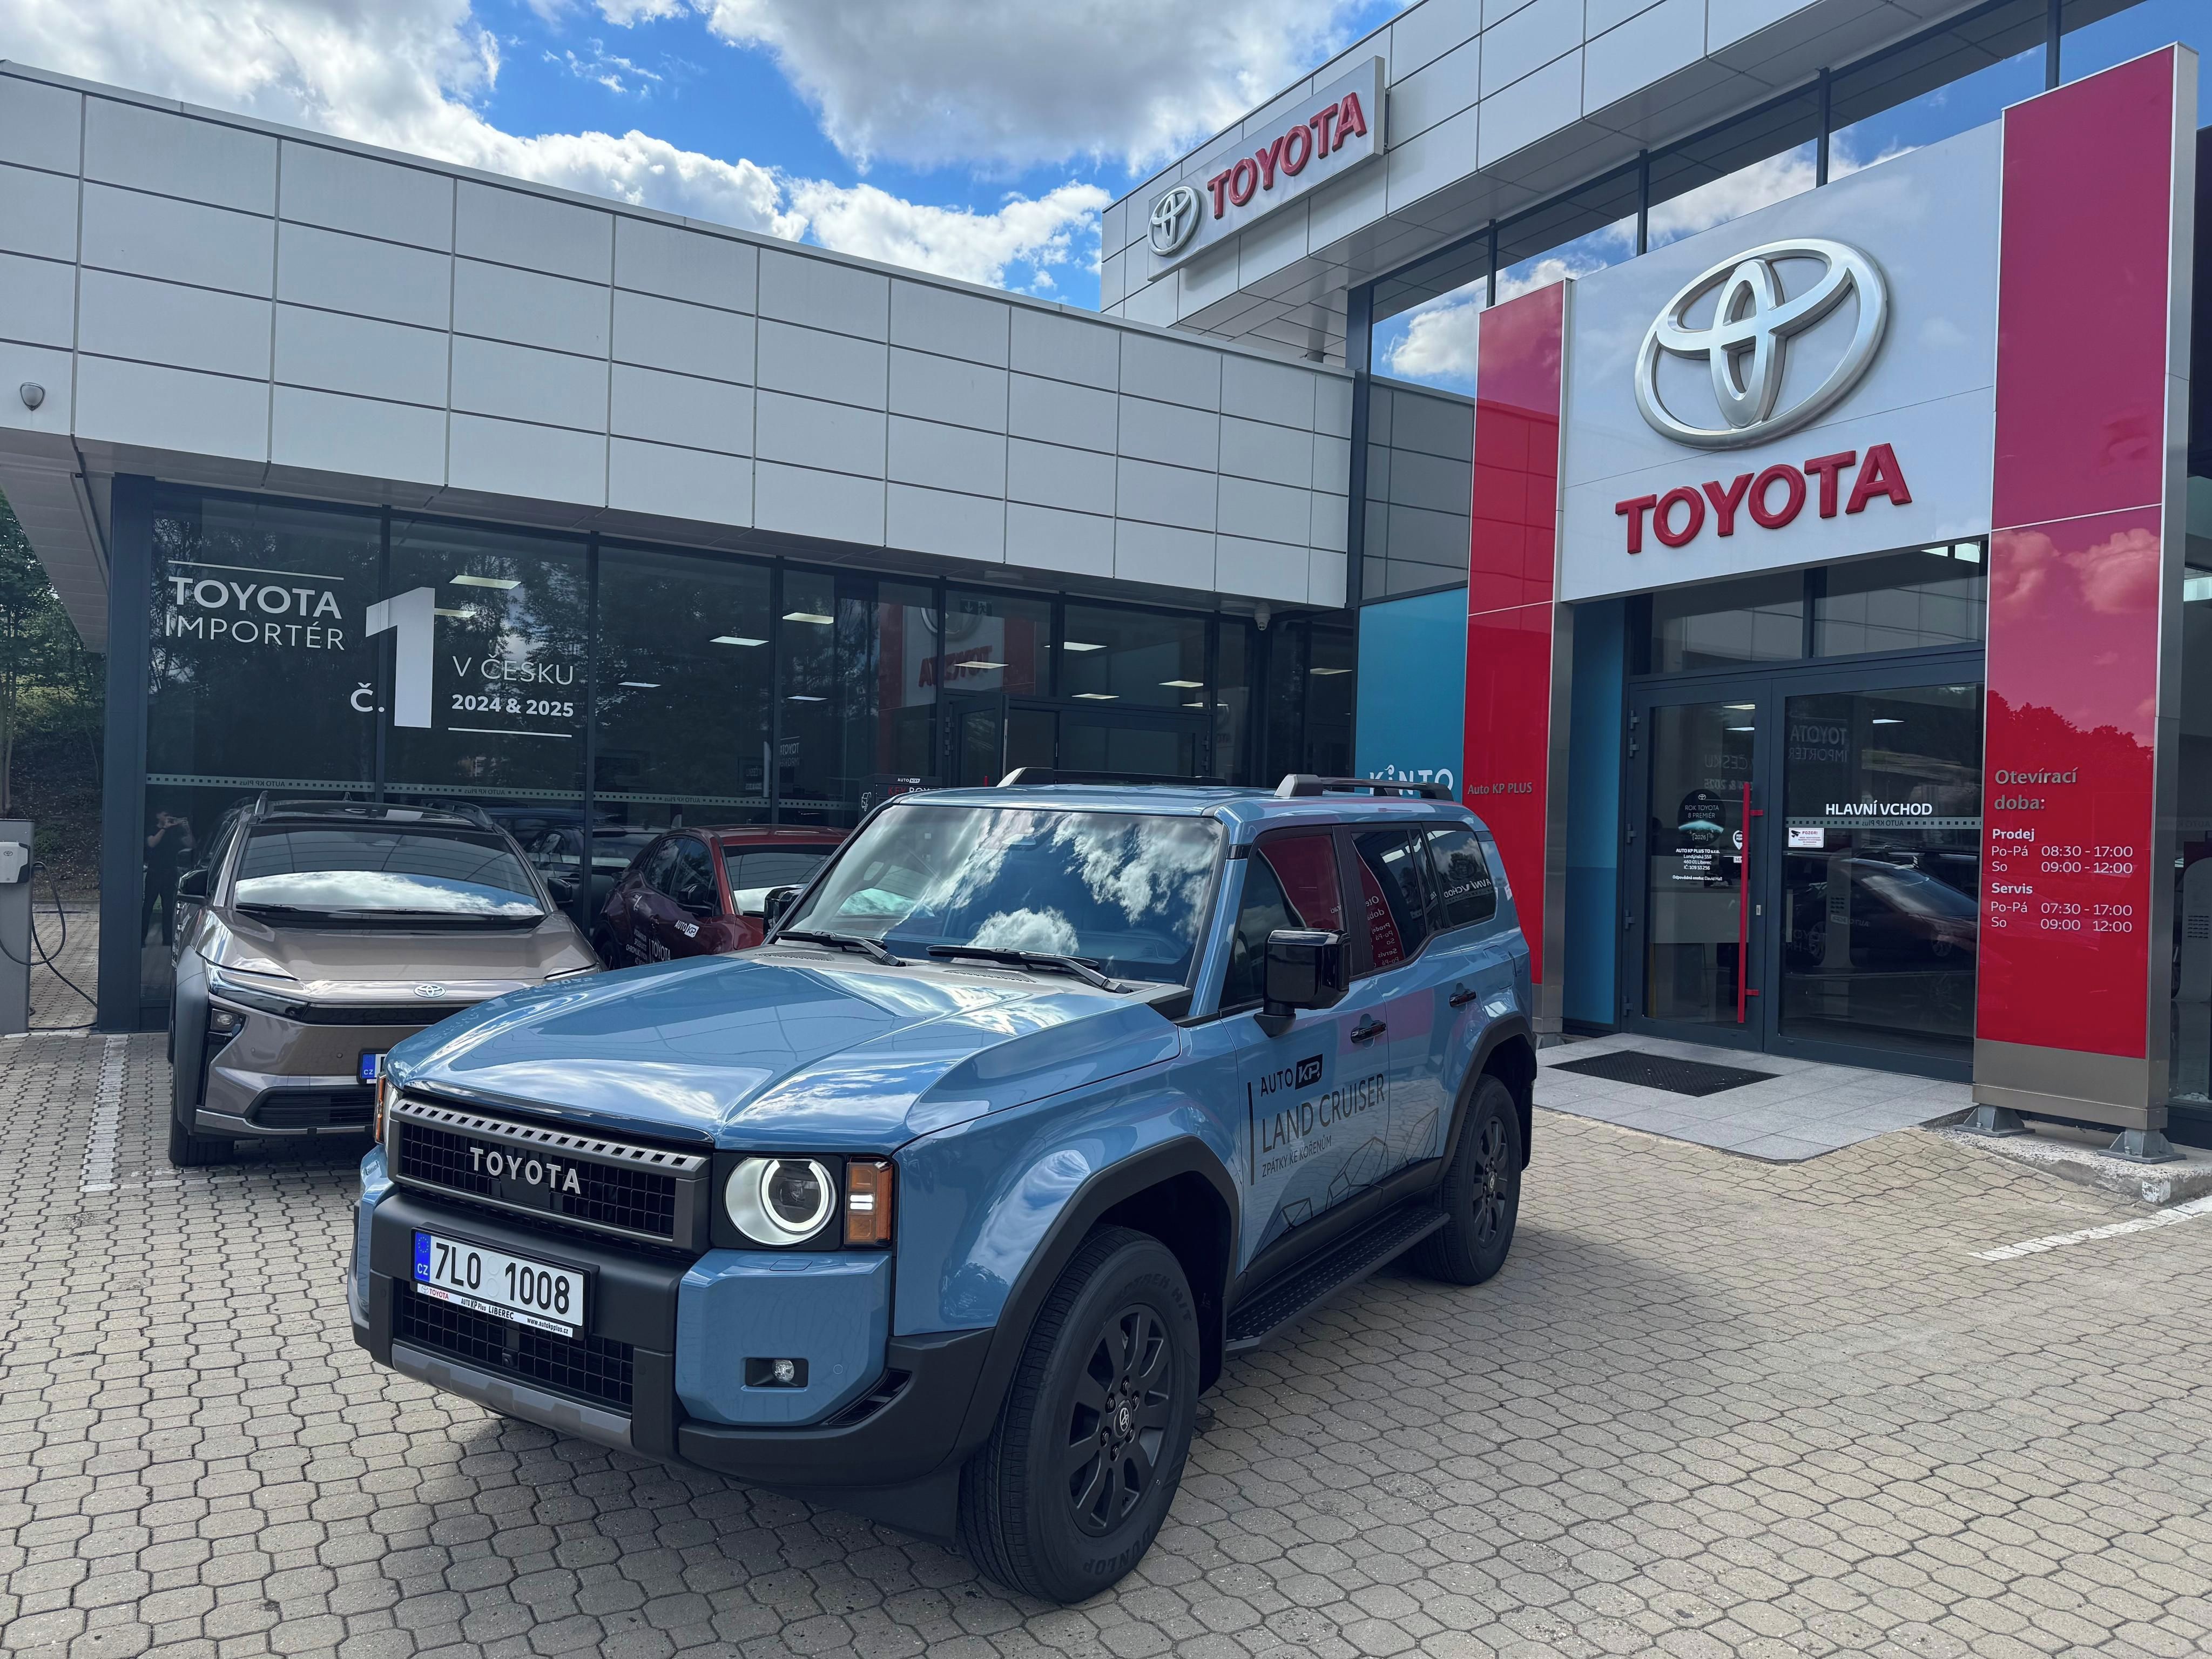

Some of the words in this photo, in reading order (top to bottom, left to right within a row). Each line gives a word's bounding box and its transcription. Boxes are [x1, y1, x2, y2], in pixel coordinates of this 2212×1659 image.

[1207, 92, 1367, 220] TOYOTA
[1615, 442, 1913, 554] TOYOTA
[168, 575, 342, 620] TOYOTA
[164, 613, 345, 651] IMPORTÉR
[365, 586, 435, 729] 1
[453, 655, 472, 677] V
[481, 653, 574, 686] ČESKU
[350, 682, 385, 713] Č.
[451, 693, 501, 713] 2024
[505, 696, 522, 714] &
[525, 698, 574, 718] 2025
[1467, 784, 1489, 794] Auto
[1492, 784, 1505, 794] KP
[1507, 782, 1533, 794] PLUS
[1995, 767, 2078, 784] Otevírací
[1826, 799, 1877, 815] HLAVNÍ
[1880, 803, 1932, 816] VCHOD
[1994, 794, 2046, 810] doba:
[1992, 828, 2035, 841] Prodej
[1991, 845, 2028, 857] Po-Pá
[2041, 846, 2081, 857] 08:30
[2094, 846, 2133, 857] 17:00
[1992, 862, 2007, 872] So
[2041, 861, 2081, 873] 09:00
[2093, 862, 2133, 874] 12:00
[1991, 882, 2033, 894] Servis
[1991, 901, 2028, 913] Po-Pá
[2041, 903, 2081, 914] 07:30
[2093, 905, 2133, 916] 17:00
[675, 920, 687, 932] AUTO
[1991, 916, 2007, 928] So
[2040, 919, 2081, 930] 09:00
[2093, 920, 2132, 932] 12:00
[651, 940, 671, 961] TOYOTA
[1260, 1068, 1293, 1097] AUTO
[1262, 1101, 1314, 1154] LAND
[1319, 1073, 1385, 1128] CRUISER
[1262, 1152, 1288, 1178] ZPÁTKY
[1289, 1150, 1299, 1164] KE
[1299, 1134, 1332, 1161] KOŘENŮM
[470, 1147, 581, 1195] TOYOTA
[416, 1263, 429, 1277] CZ
[504, 1262, 570, 1315] 1008
[428, 1286, 449, 1300] TOYOTA
[461, 1297, 470, 1307] AUTO
[470, 1299, 478, 1309] KP
[478, 1301, 487, 1312] Plus
[488, 1304, 514, 1320] LIBEREC
[527, 1316, 569, 1335] www.autokpplus.cz
